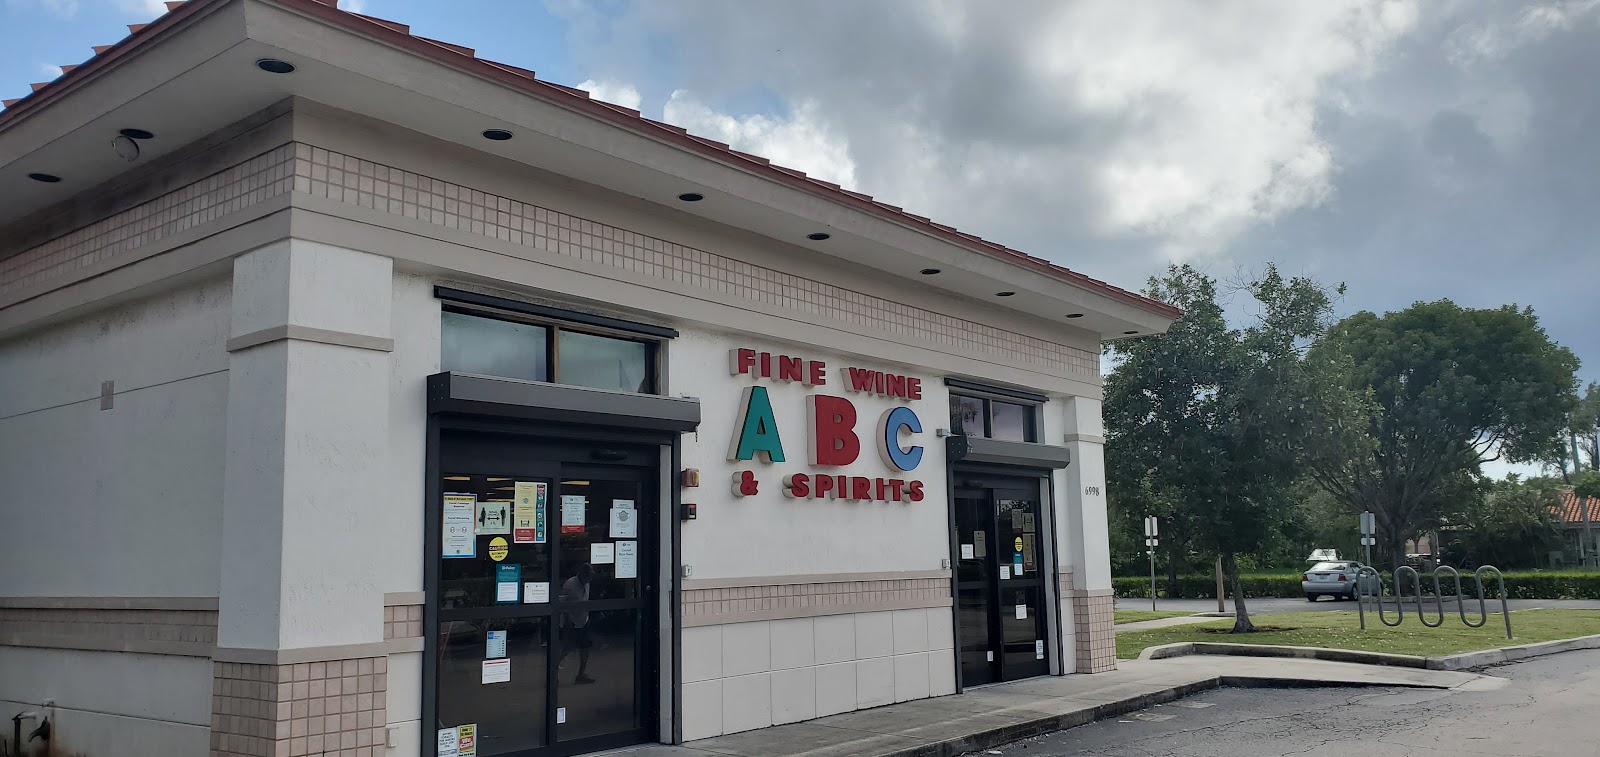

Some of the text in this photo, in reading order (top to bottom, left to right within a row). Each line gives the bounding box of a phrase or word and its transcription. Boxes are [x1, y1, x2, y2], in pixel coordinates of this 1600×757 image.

[731, 347, 922, 401] FINE WINE
[736, 470, 925, 502] & SPIRITS
[1085, 486, 1100, 497] 6998
